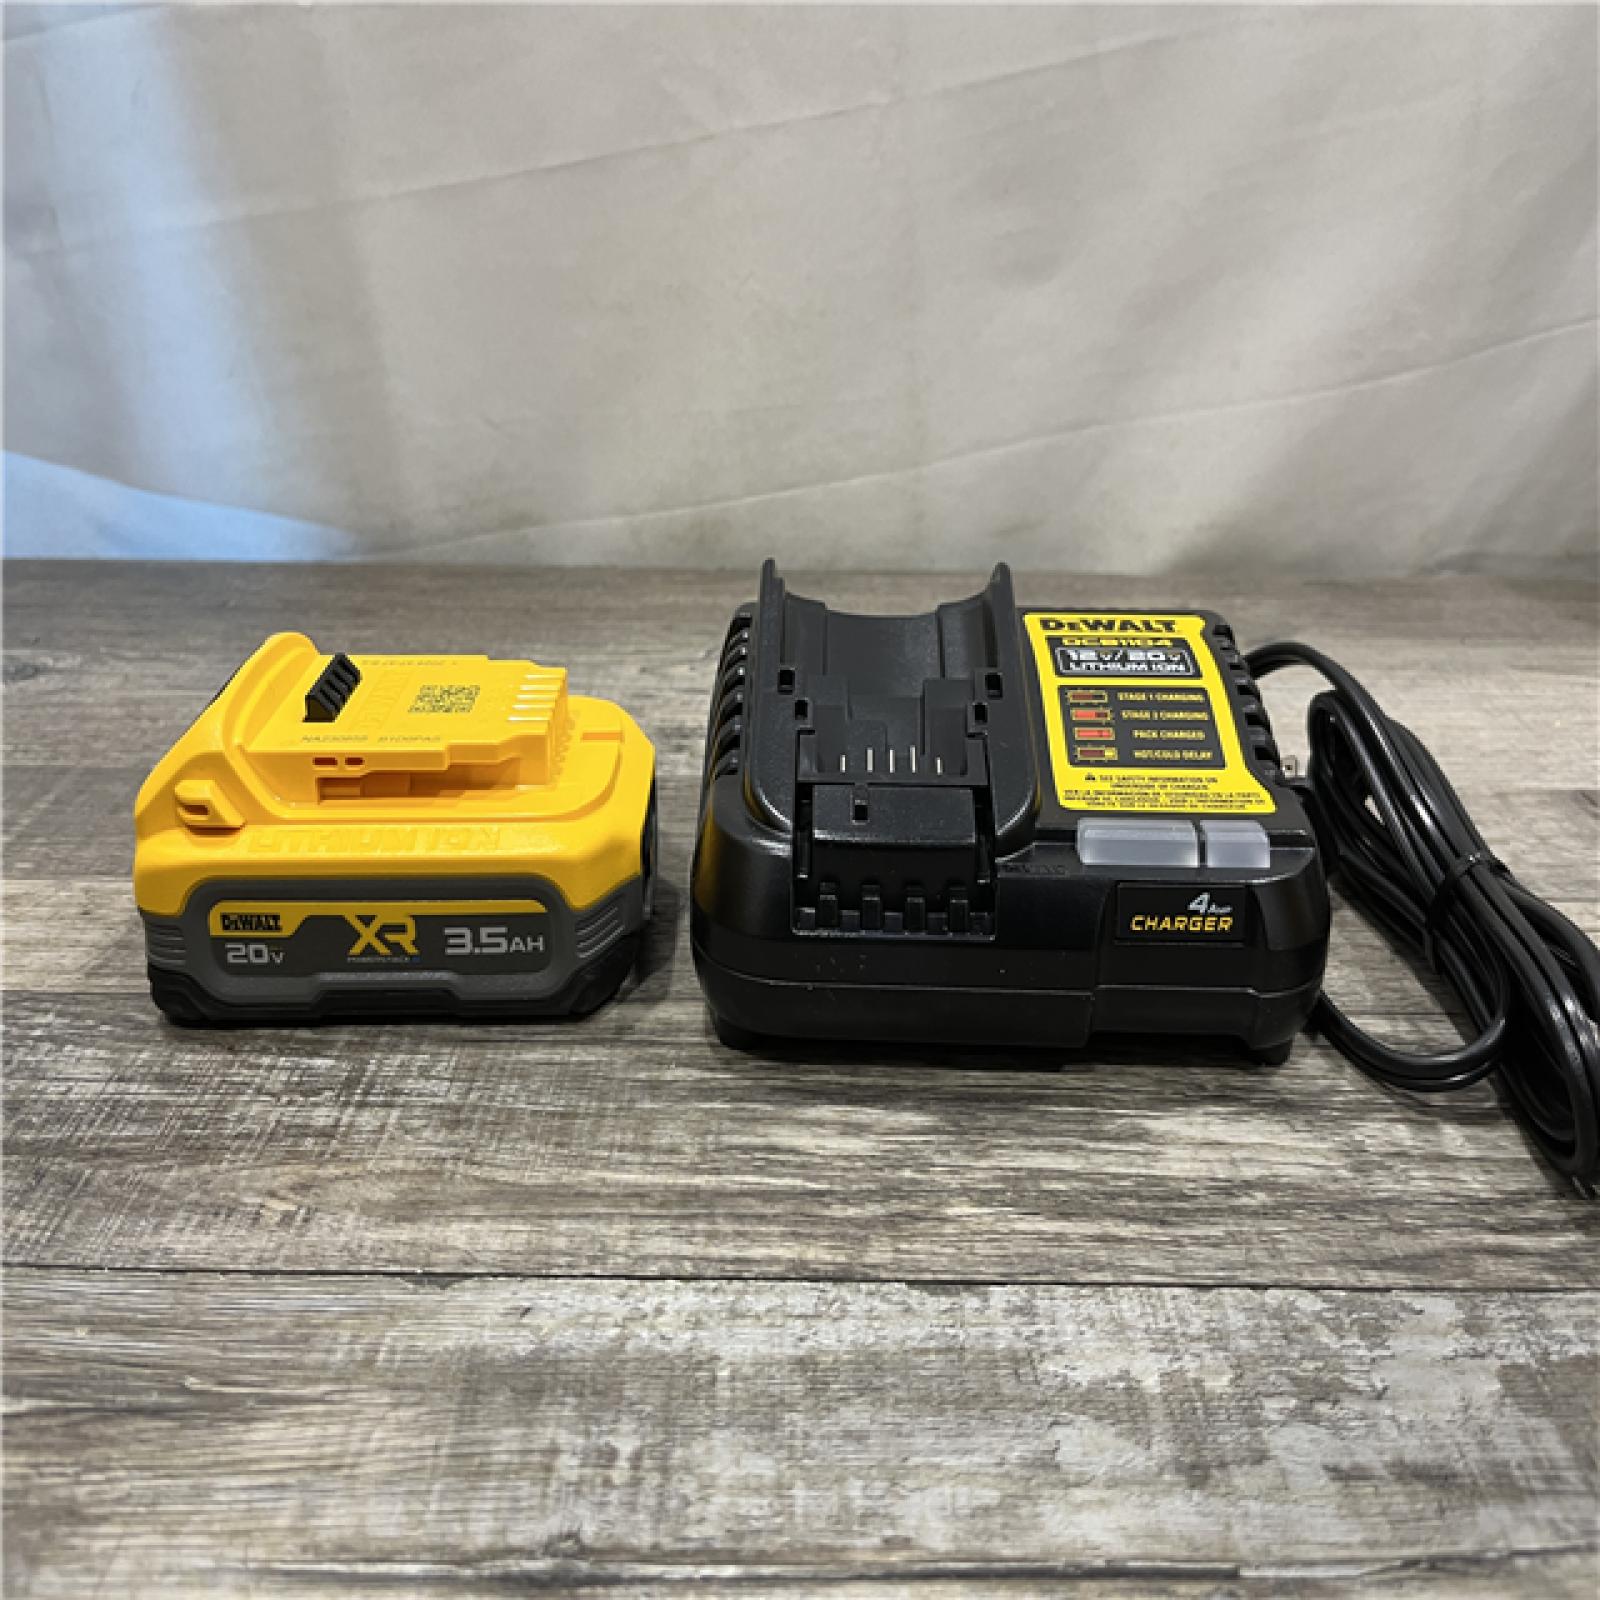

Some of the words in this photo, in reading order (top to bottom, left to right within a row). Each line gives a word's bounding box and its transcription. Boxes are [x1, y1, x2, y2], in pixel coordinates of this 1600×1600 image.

[1040, 619, 1176, 633] DEWALT
[1069, 661, 1148, 672] LITHIUM
[1117, 691, 1146, 701] STAGE
[1155, 692, 1205, 702] CHARGING
[1121, 710, 1151, 720] STAGE
[1159, 710, 1209, 721] CHARGING
[1132, 729, 1158, 739] PACK
[220, 912, 283, 932] DEWALT
[1130, 915, 1234, 932] CHARGER
[344, 914, 420, 956] XR
